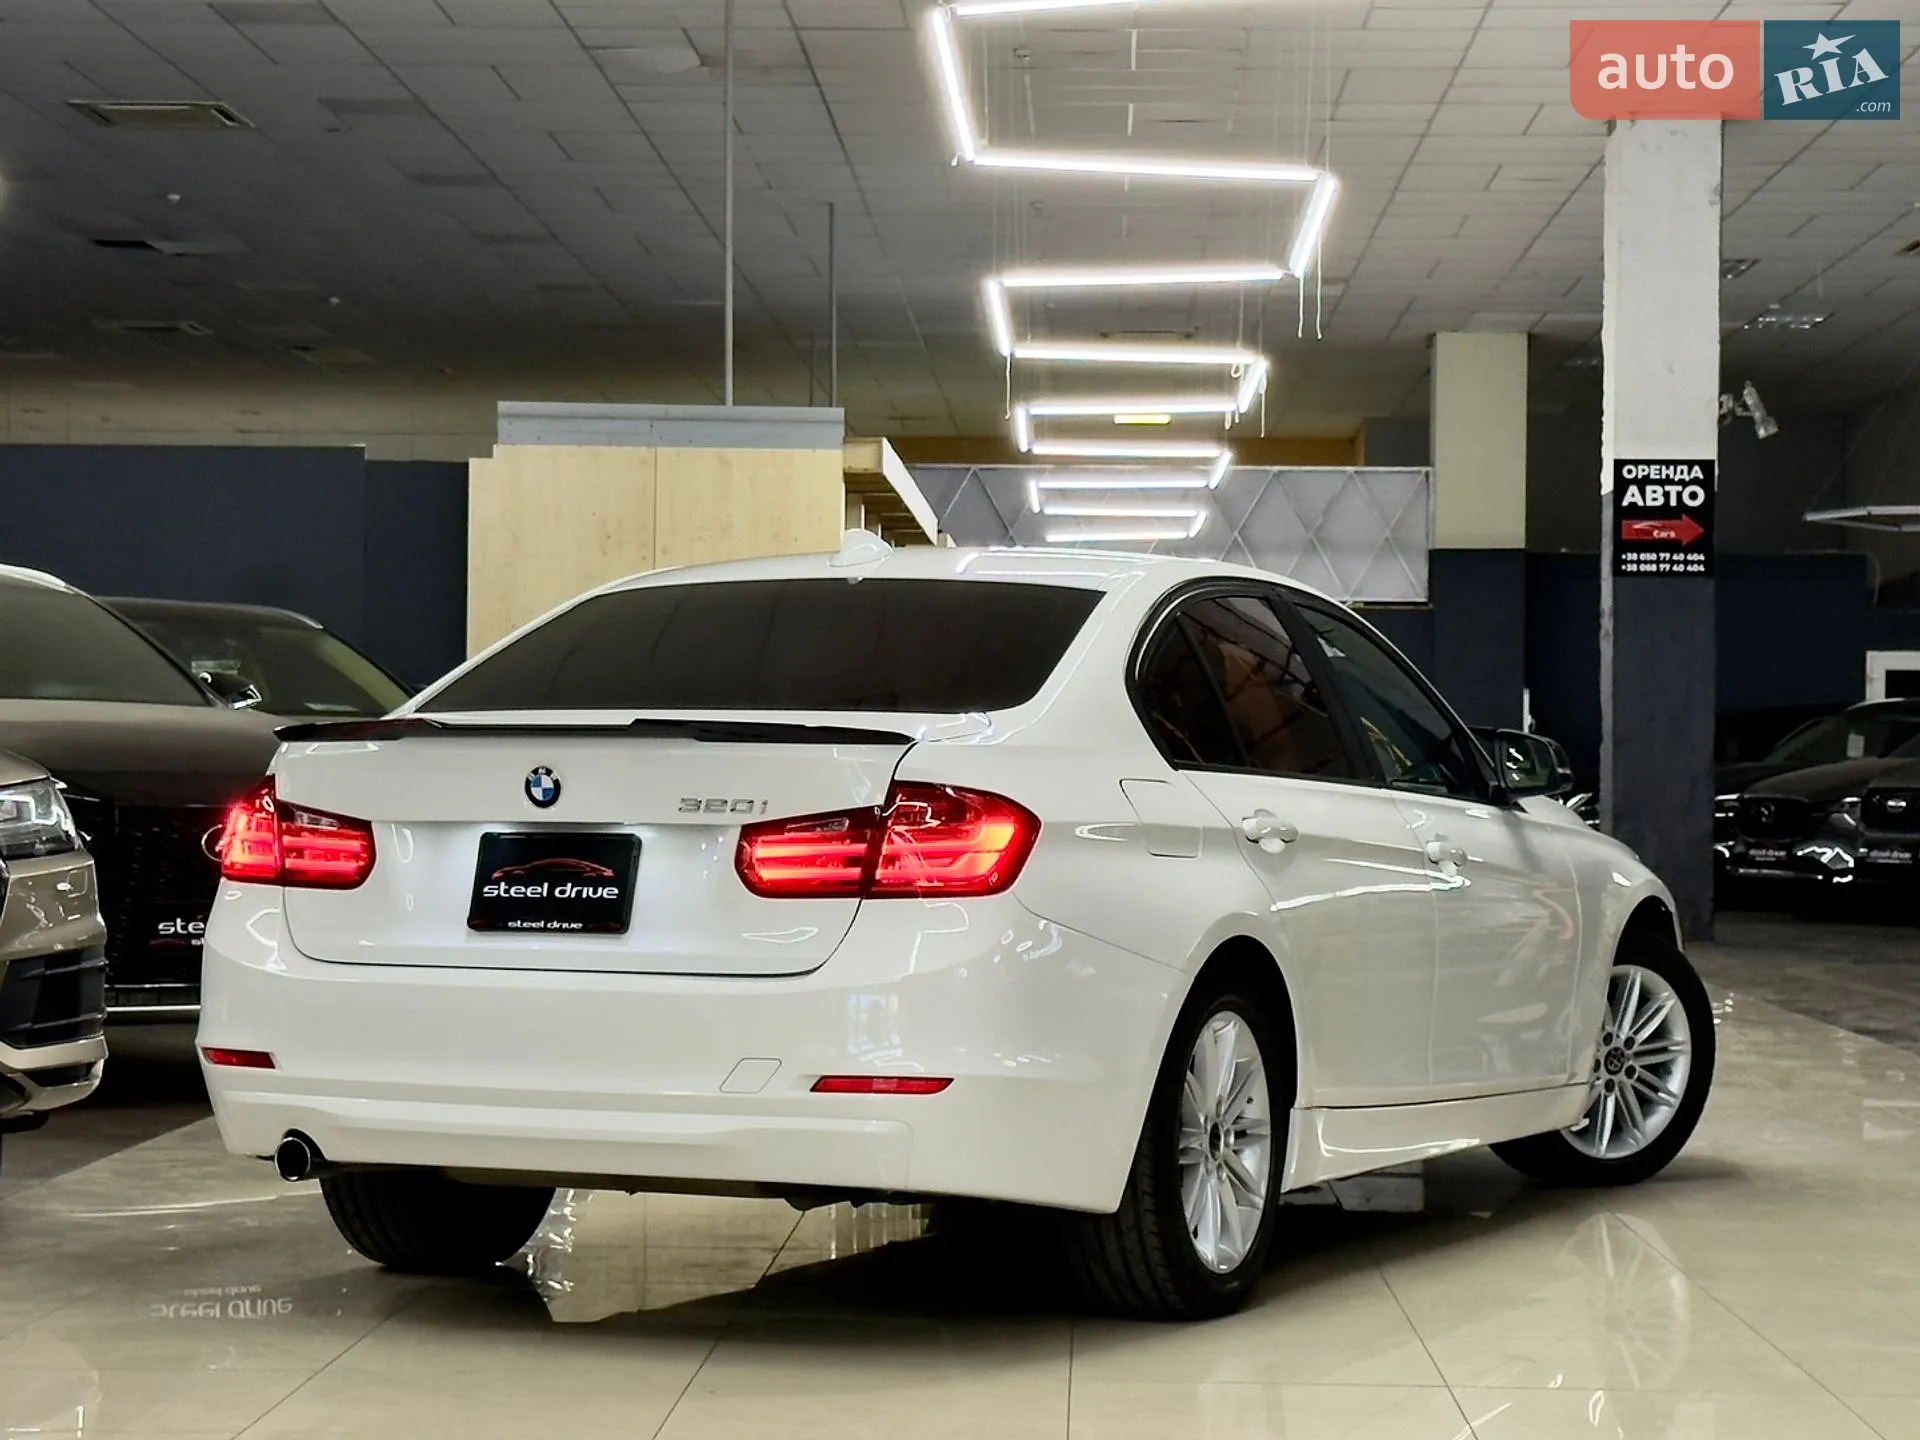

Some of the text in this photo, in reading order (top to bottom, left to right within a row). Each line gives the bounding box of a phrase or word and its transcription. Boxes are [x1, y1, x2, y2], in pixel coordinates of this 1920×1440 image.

[1622, 464, 1705, 482] ОРЕНДА
[1621, 484, 1706, 508] АВТО
[1659, 552, 1671, 561] 77
[1659, 563, 1671, 572] 77
[483, 881, 620, 899] steel drive
[507, 919, 584, 930] steel drive
